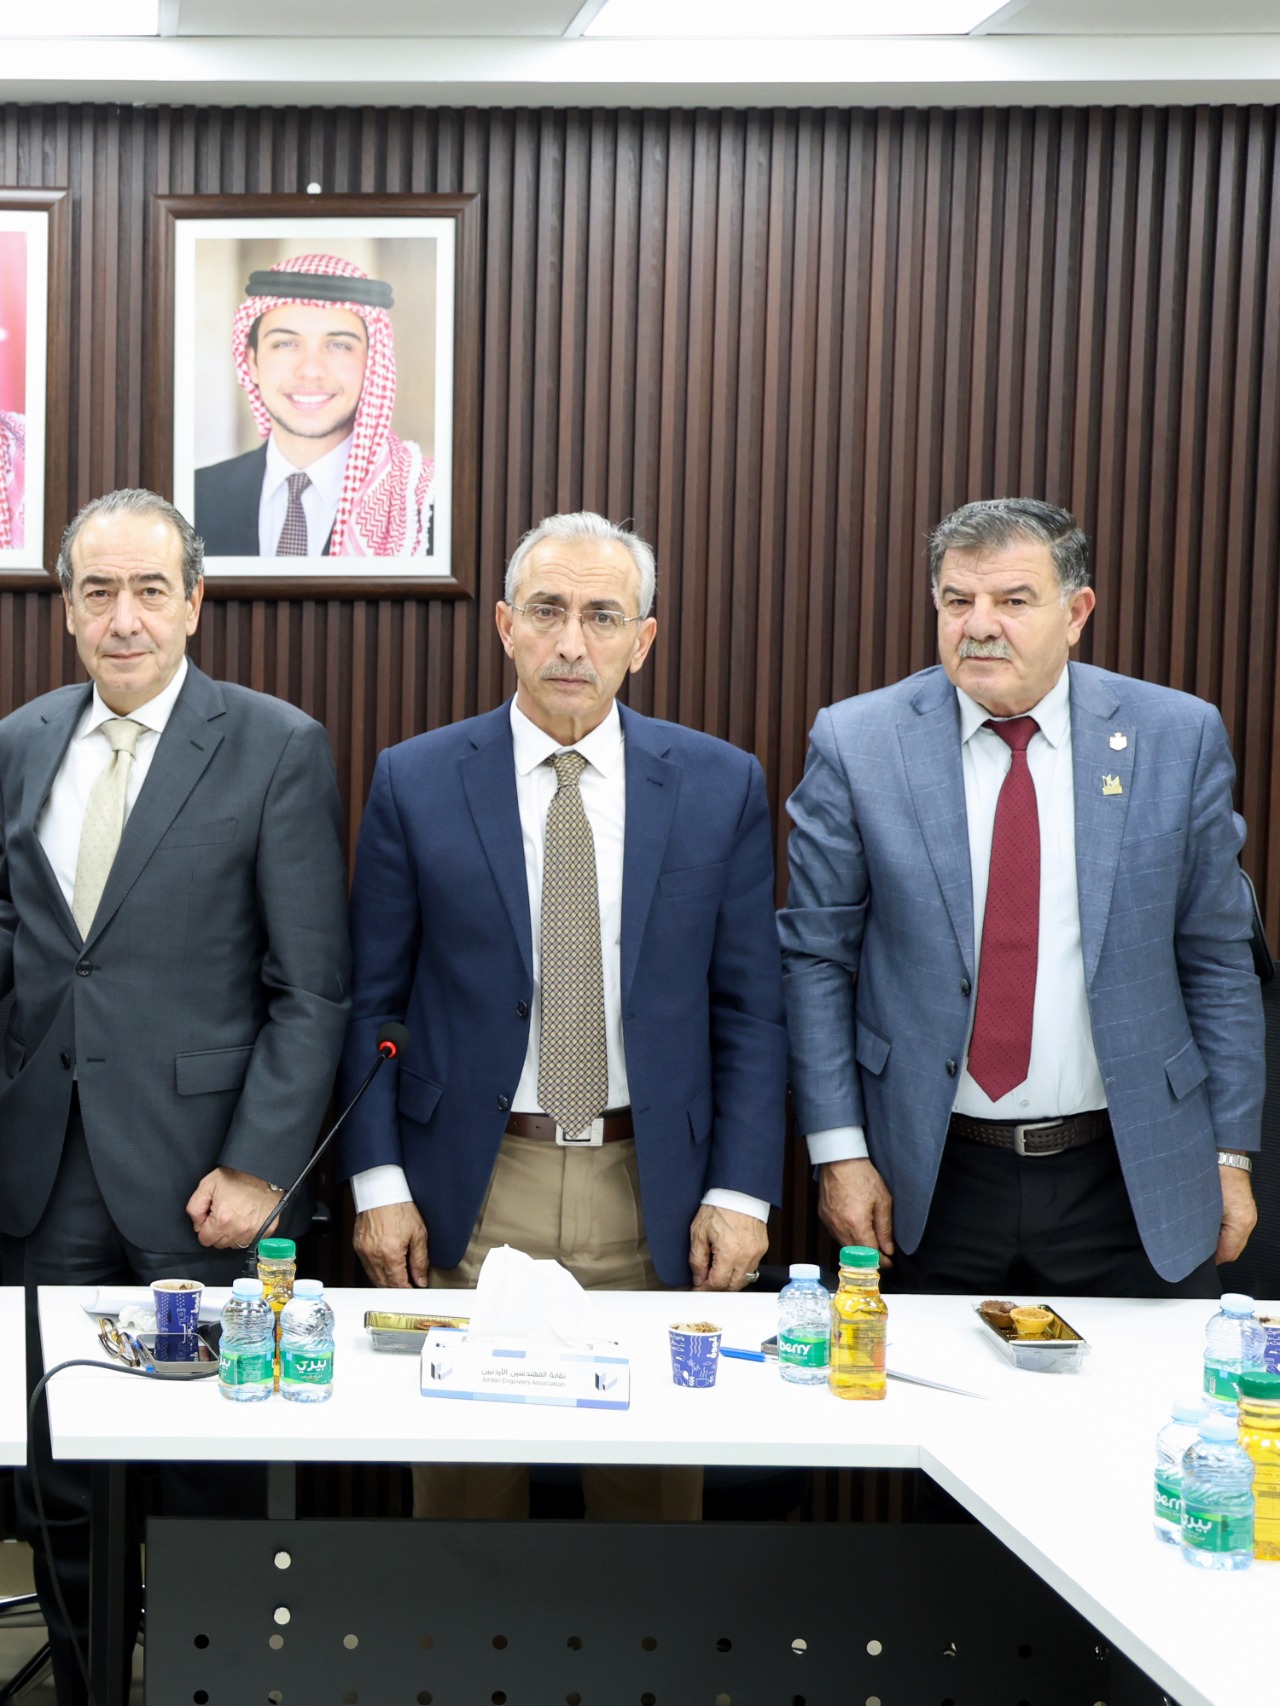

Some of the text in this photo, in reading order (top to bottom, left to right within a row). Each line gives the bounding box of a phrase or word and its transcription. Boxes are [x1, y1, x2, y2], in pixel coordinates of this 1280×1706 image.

[295, 1359, 327, 1374] بيري
[481, 1367, 566, 1379] نقابة المهندسين الأردنيين
